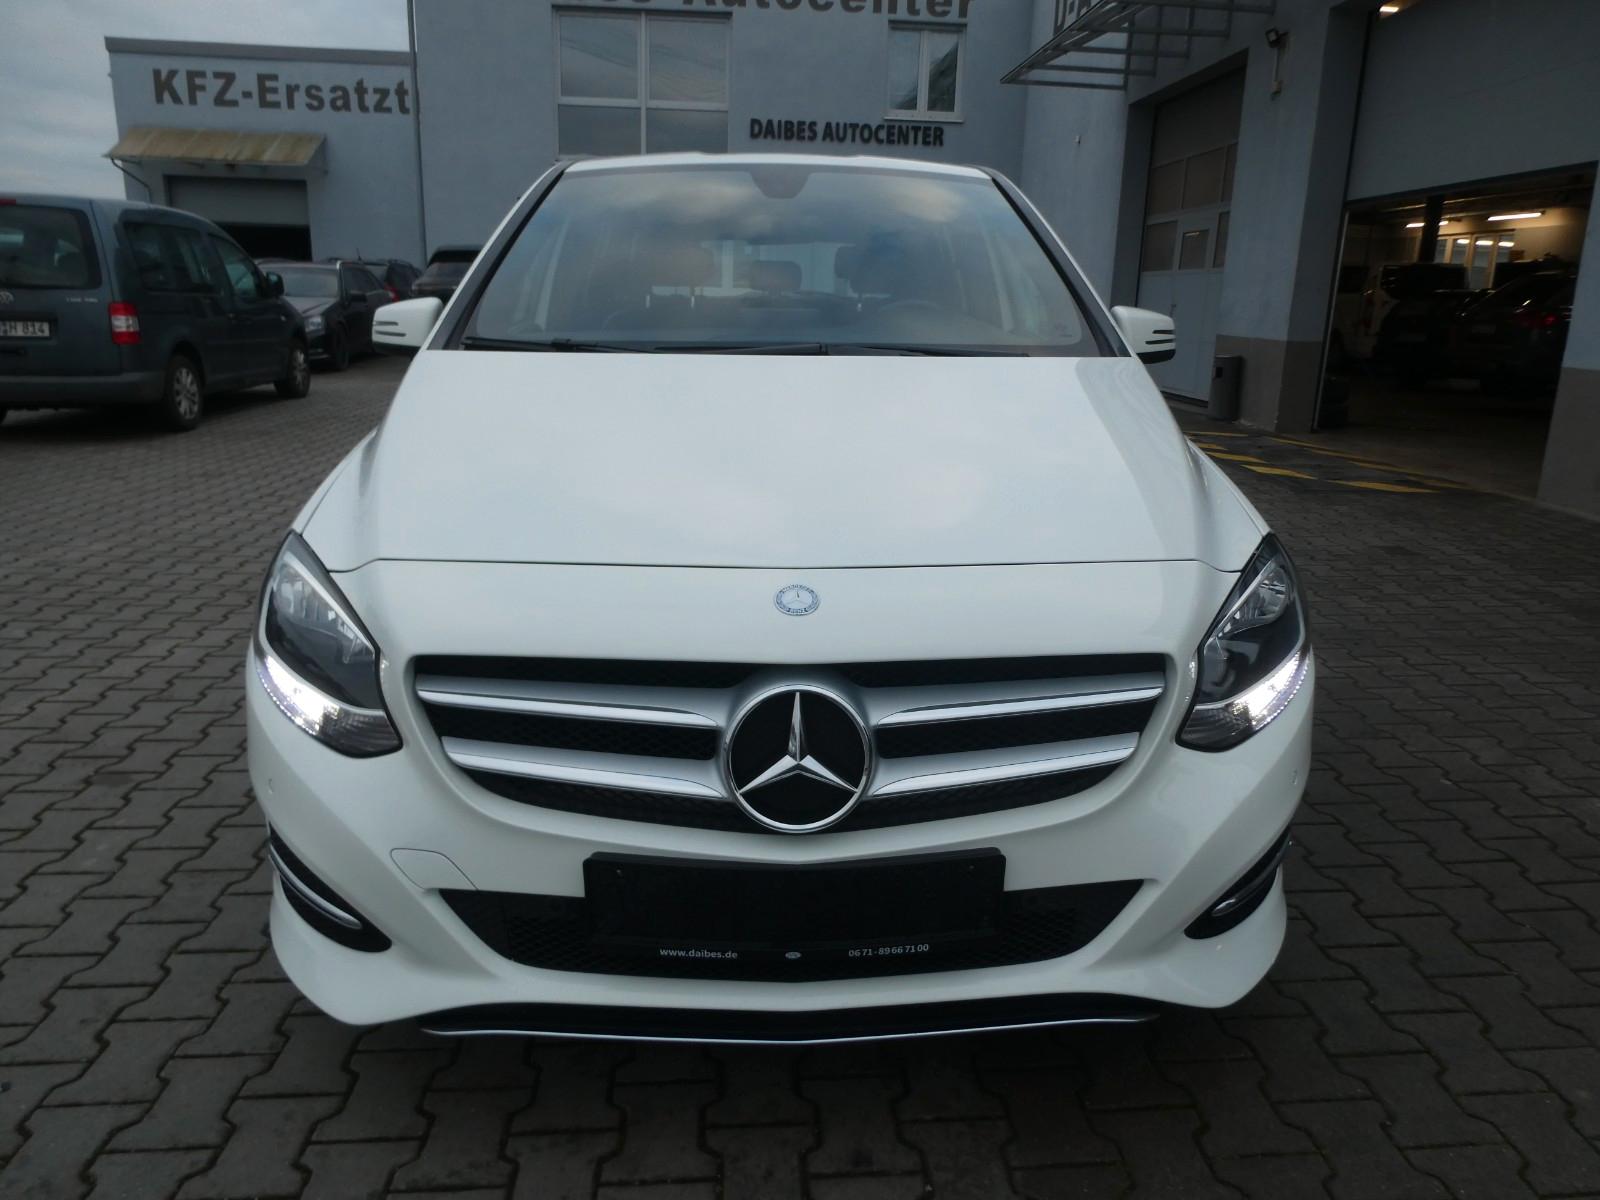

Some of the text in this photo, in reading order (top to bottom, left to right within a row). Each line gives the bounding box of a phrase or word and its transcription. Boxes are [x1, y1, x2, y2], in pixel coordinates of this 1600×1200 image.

[681, 0, 973, 20] center
[153, 68, 411, 114] KFZ-Ersatzt
[750, 119, 945, 147] DAIBES AUTOCENTER
[659, 948, 738, 961] www.daibes.de
